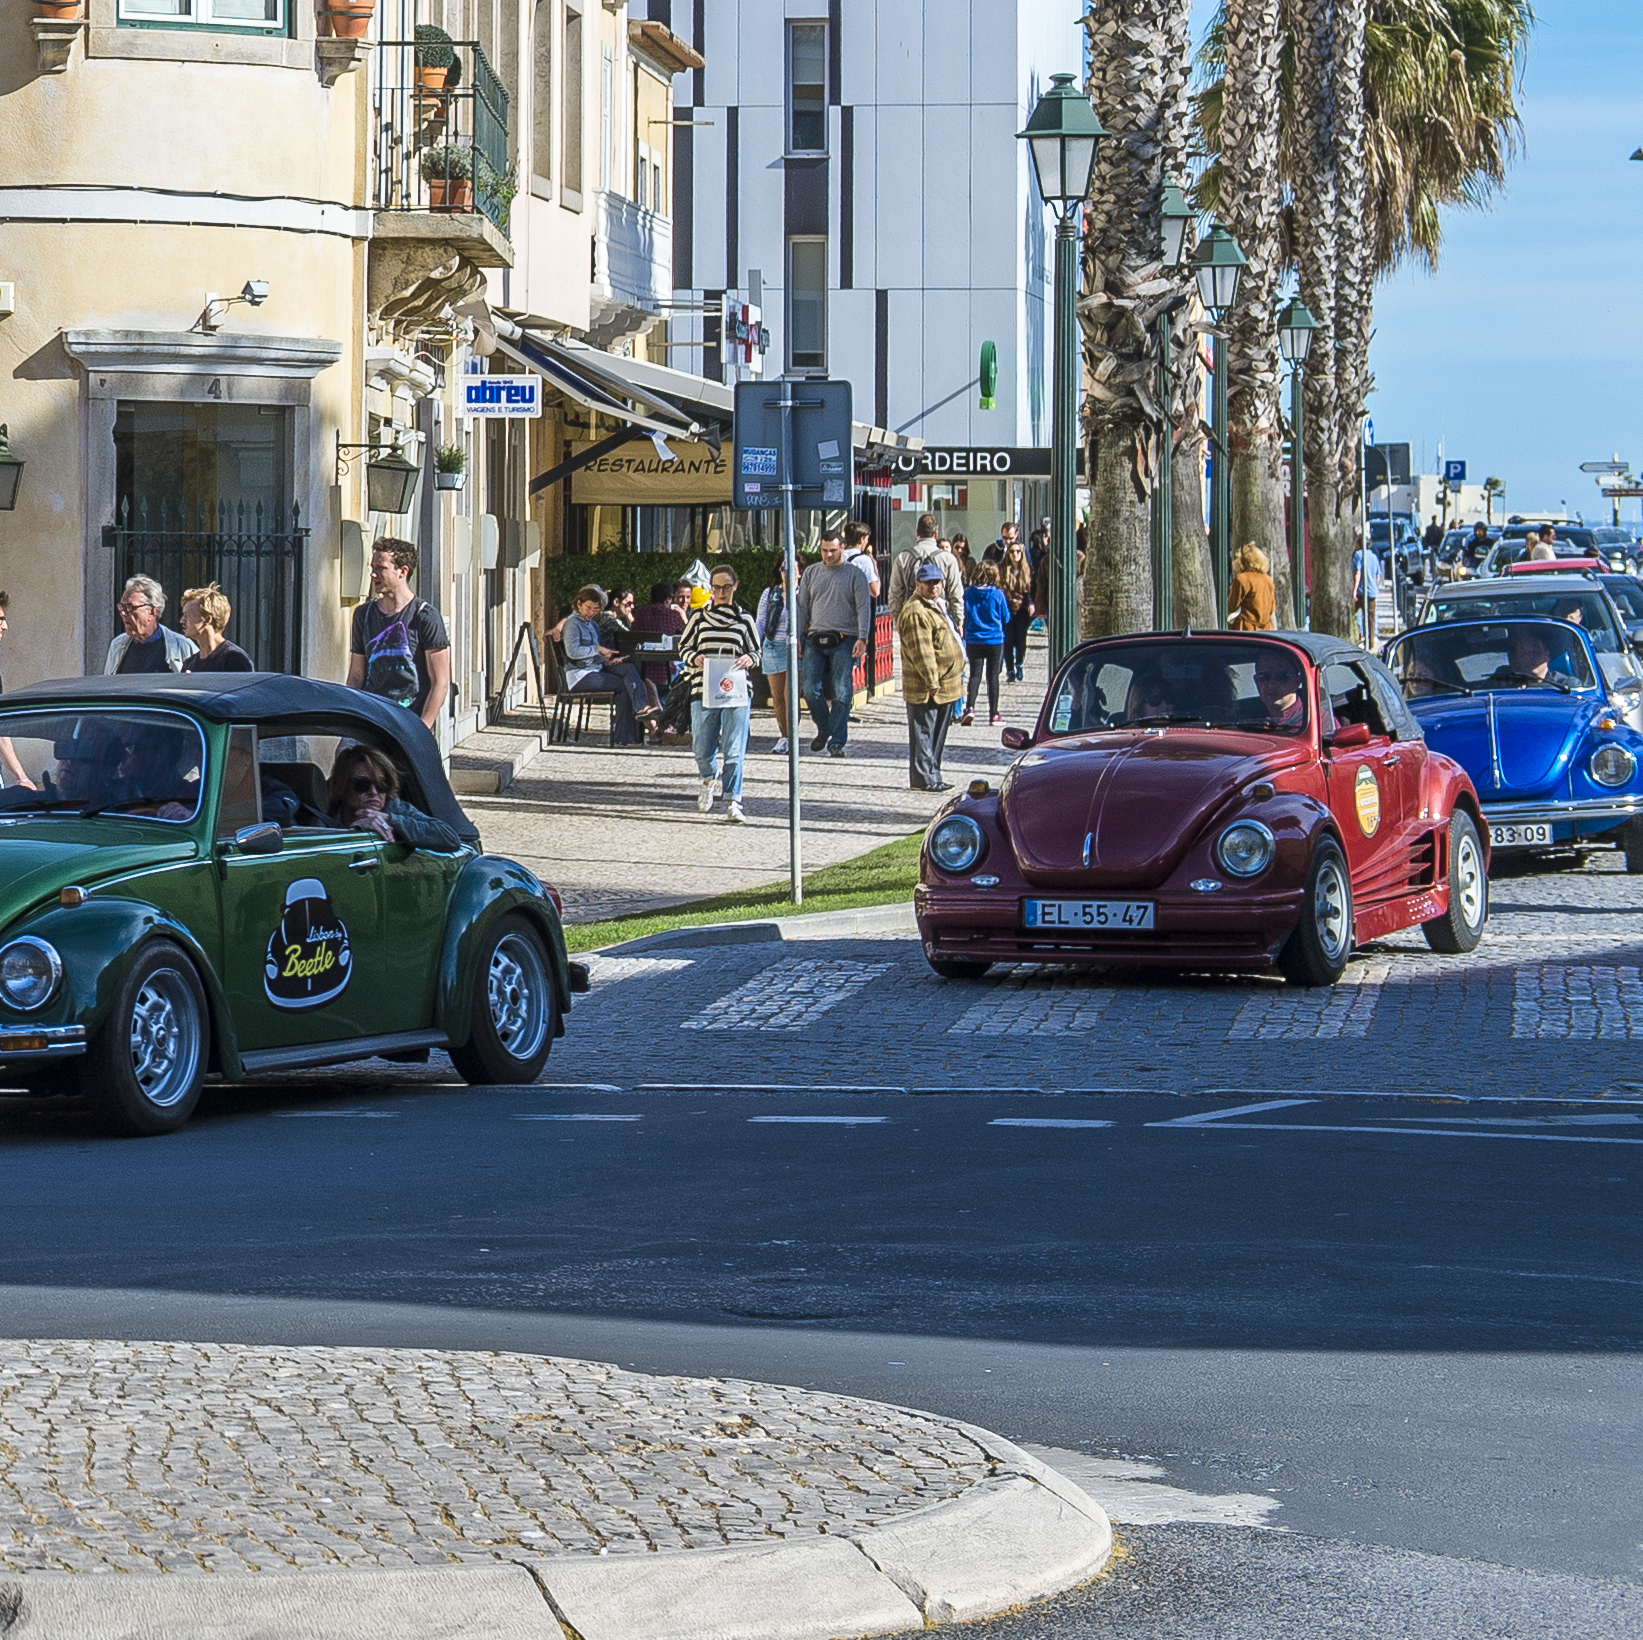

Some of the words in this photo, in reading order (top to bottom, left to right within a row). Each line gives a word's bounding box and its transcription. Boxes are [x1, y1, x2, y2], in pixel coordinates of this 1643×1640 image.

[207, 377, 223, 400] 4
[466, 379, 535, 404] abreu
[466, 406, 496, 414] VIAGENS
[498, 406, 503, 414] E
[505, 406, 535, 414] TURISMO
[584, 458, 727, 475] RESTAURANTE
[891, 451, 1011, 472] ORDEIRO
[1449, 463, 1462, 477] P
[282, 941, 335, 978] Beetle
